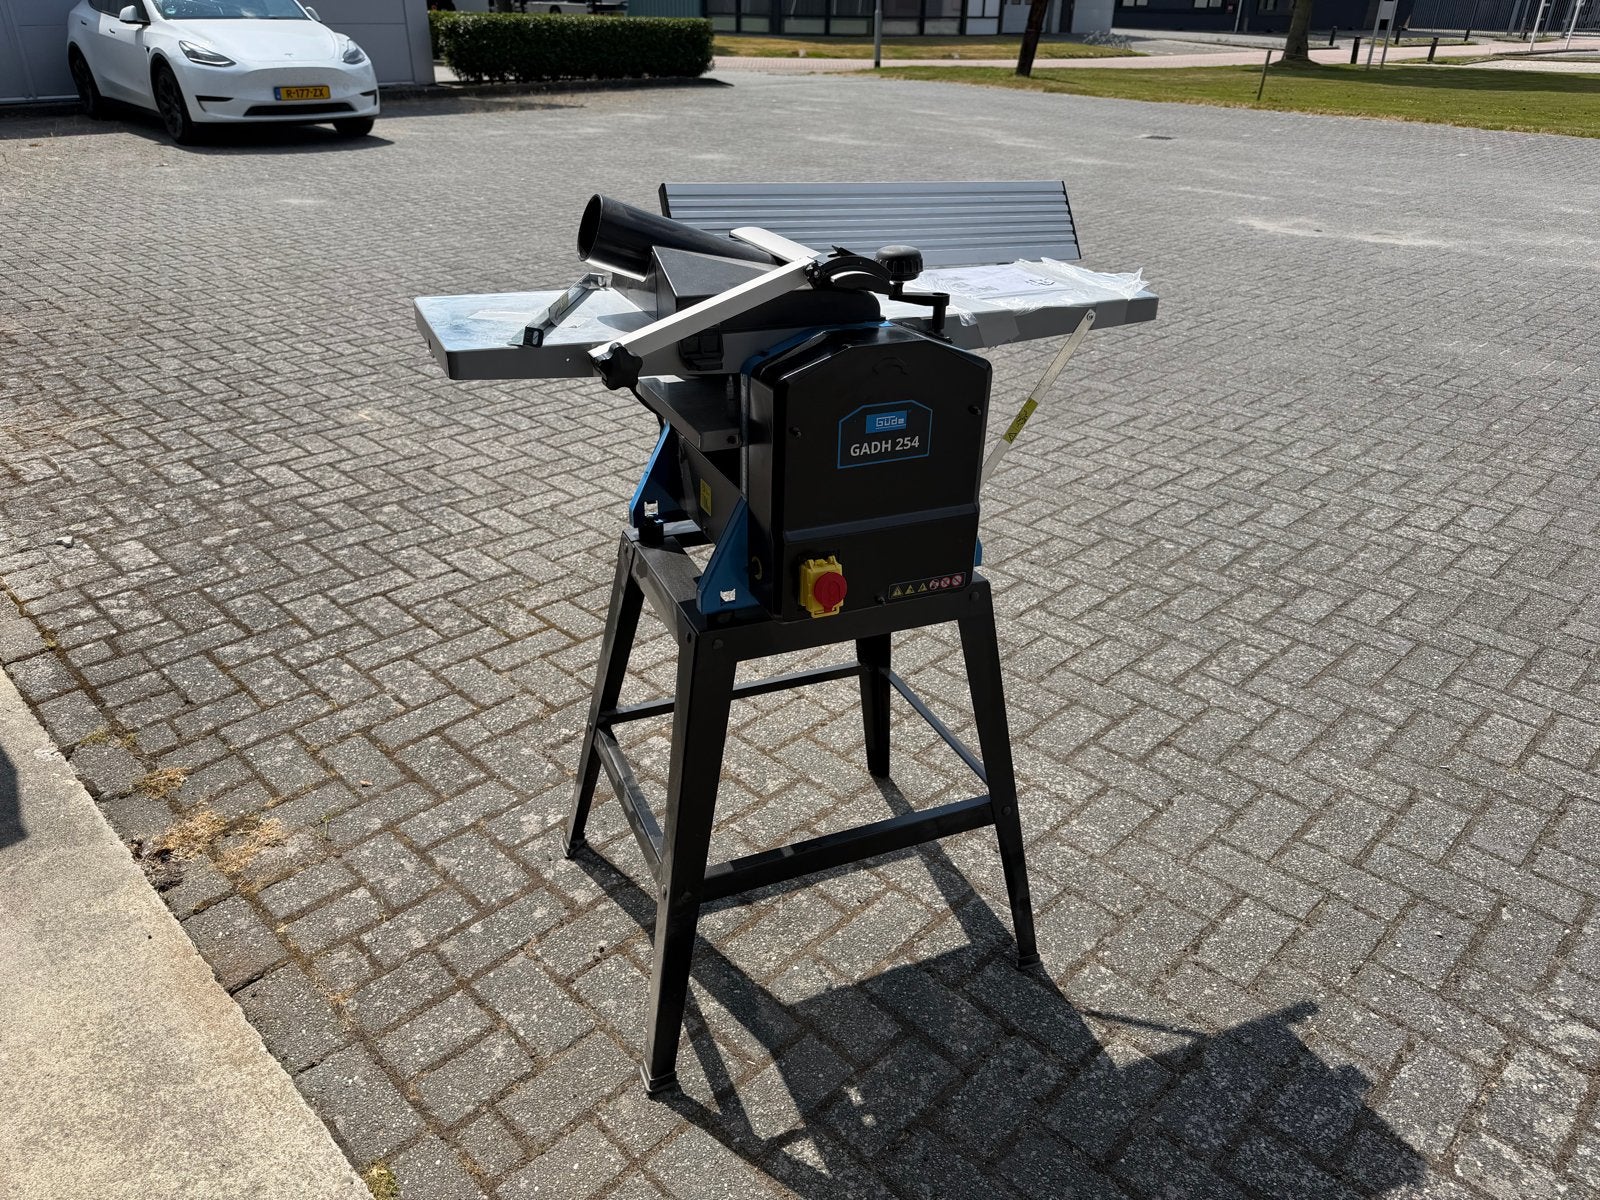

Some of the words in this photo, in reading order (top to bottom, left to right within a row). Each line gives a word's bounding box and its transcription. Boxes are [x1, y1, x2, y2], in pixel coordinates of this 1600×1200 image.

[286, 88, 325, 98] R-177-ZX
[850, 440, 892, 457] GADH
[895, 435, 920, 451] 254
